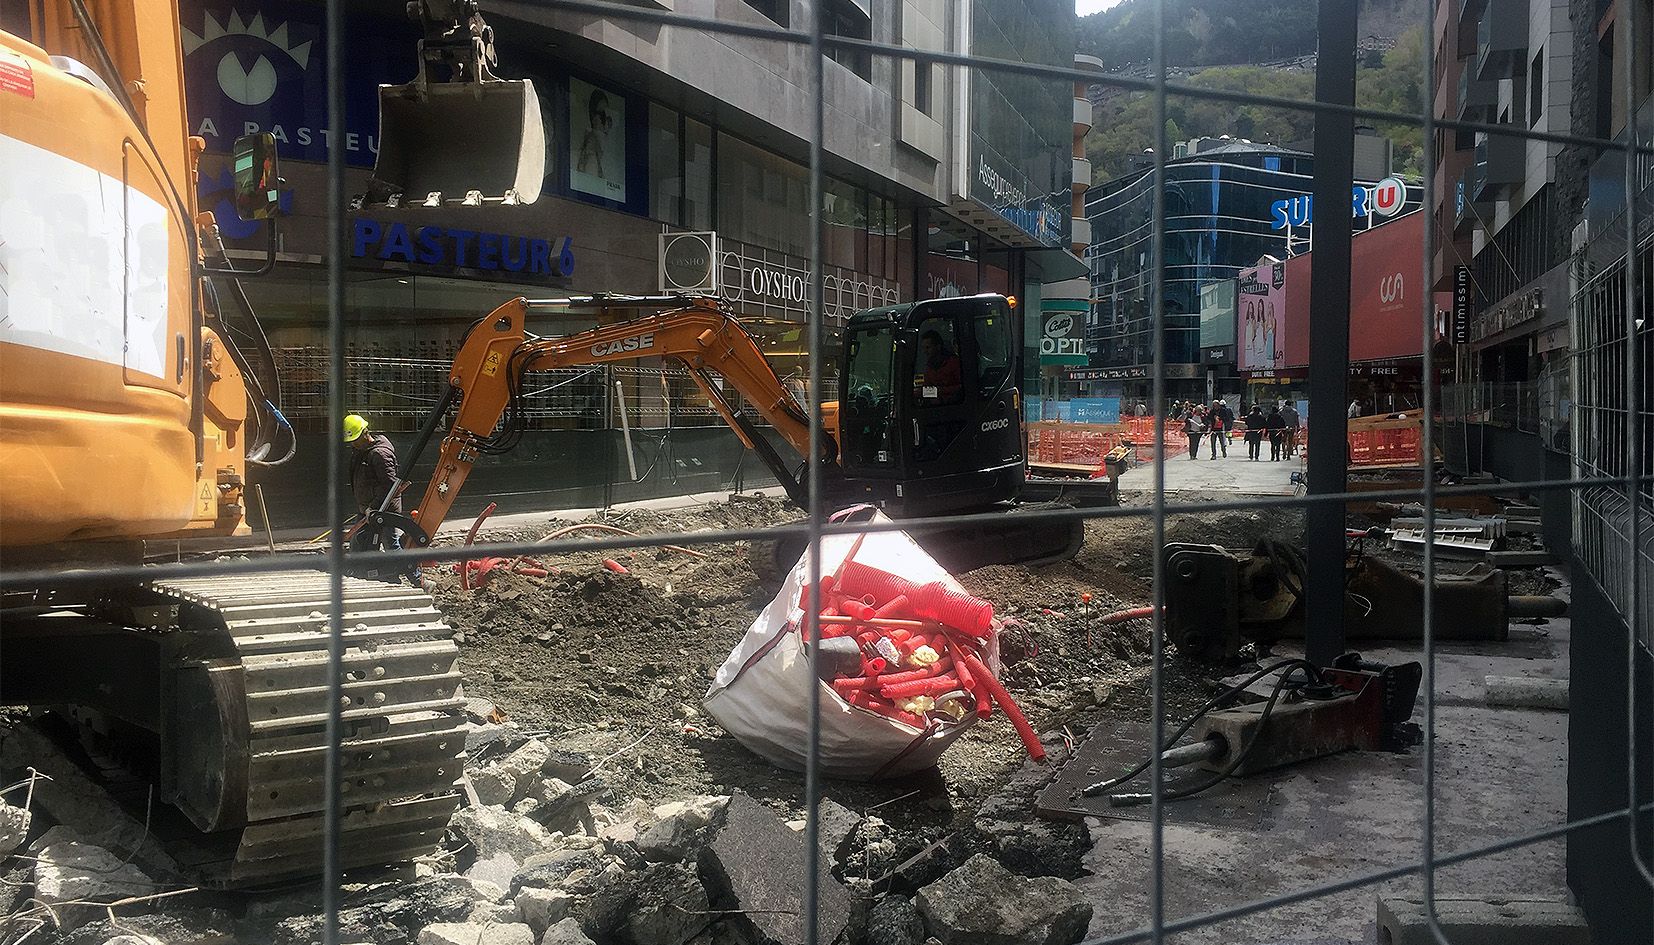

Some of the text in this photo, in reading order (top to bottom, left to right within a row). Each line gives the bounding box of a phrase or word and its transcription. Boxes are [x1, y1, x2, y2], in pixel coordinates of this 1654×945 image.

[1377, 187, 1396, 208] U
[353, 218, 575, 278] PASTEUR 6
[751, 266, 804, 303] OYSHO
[1456, 266, 1466, 343] intimissimi
[590, 332, 655, 357] CASE
[1371, 367, 1398, 375] FREE
[981, 418, 1009, 432] CX60C
